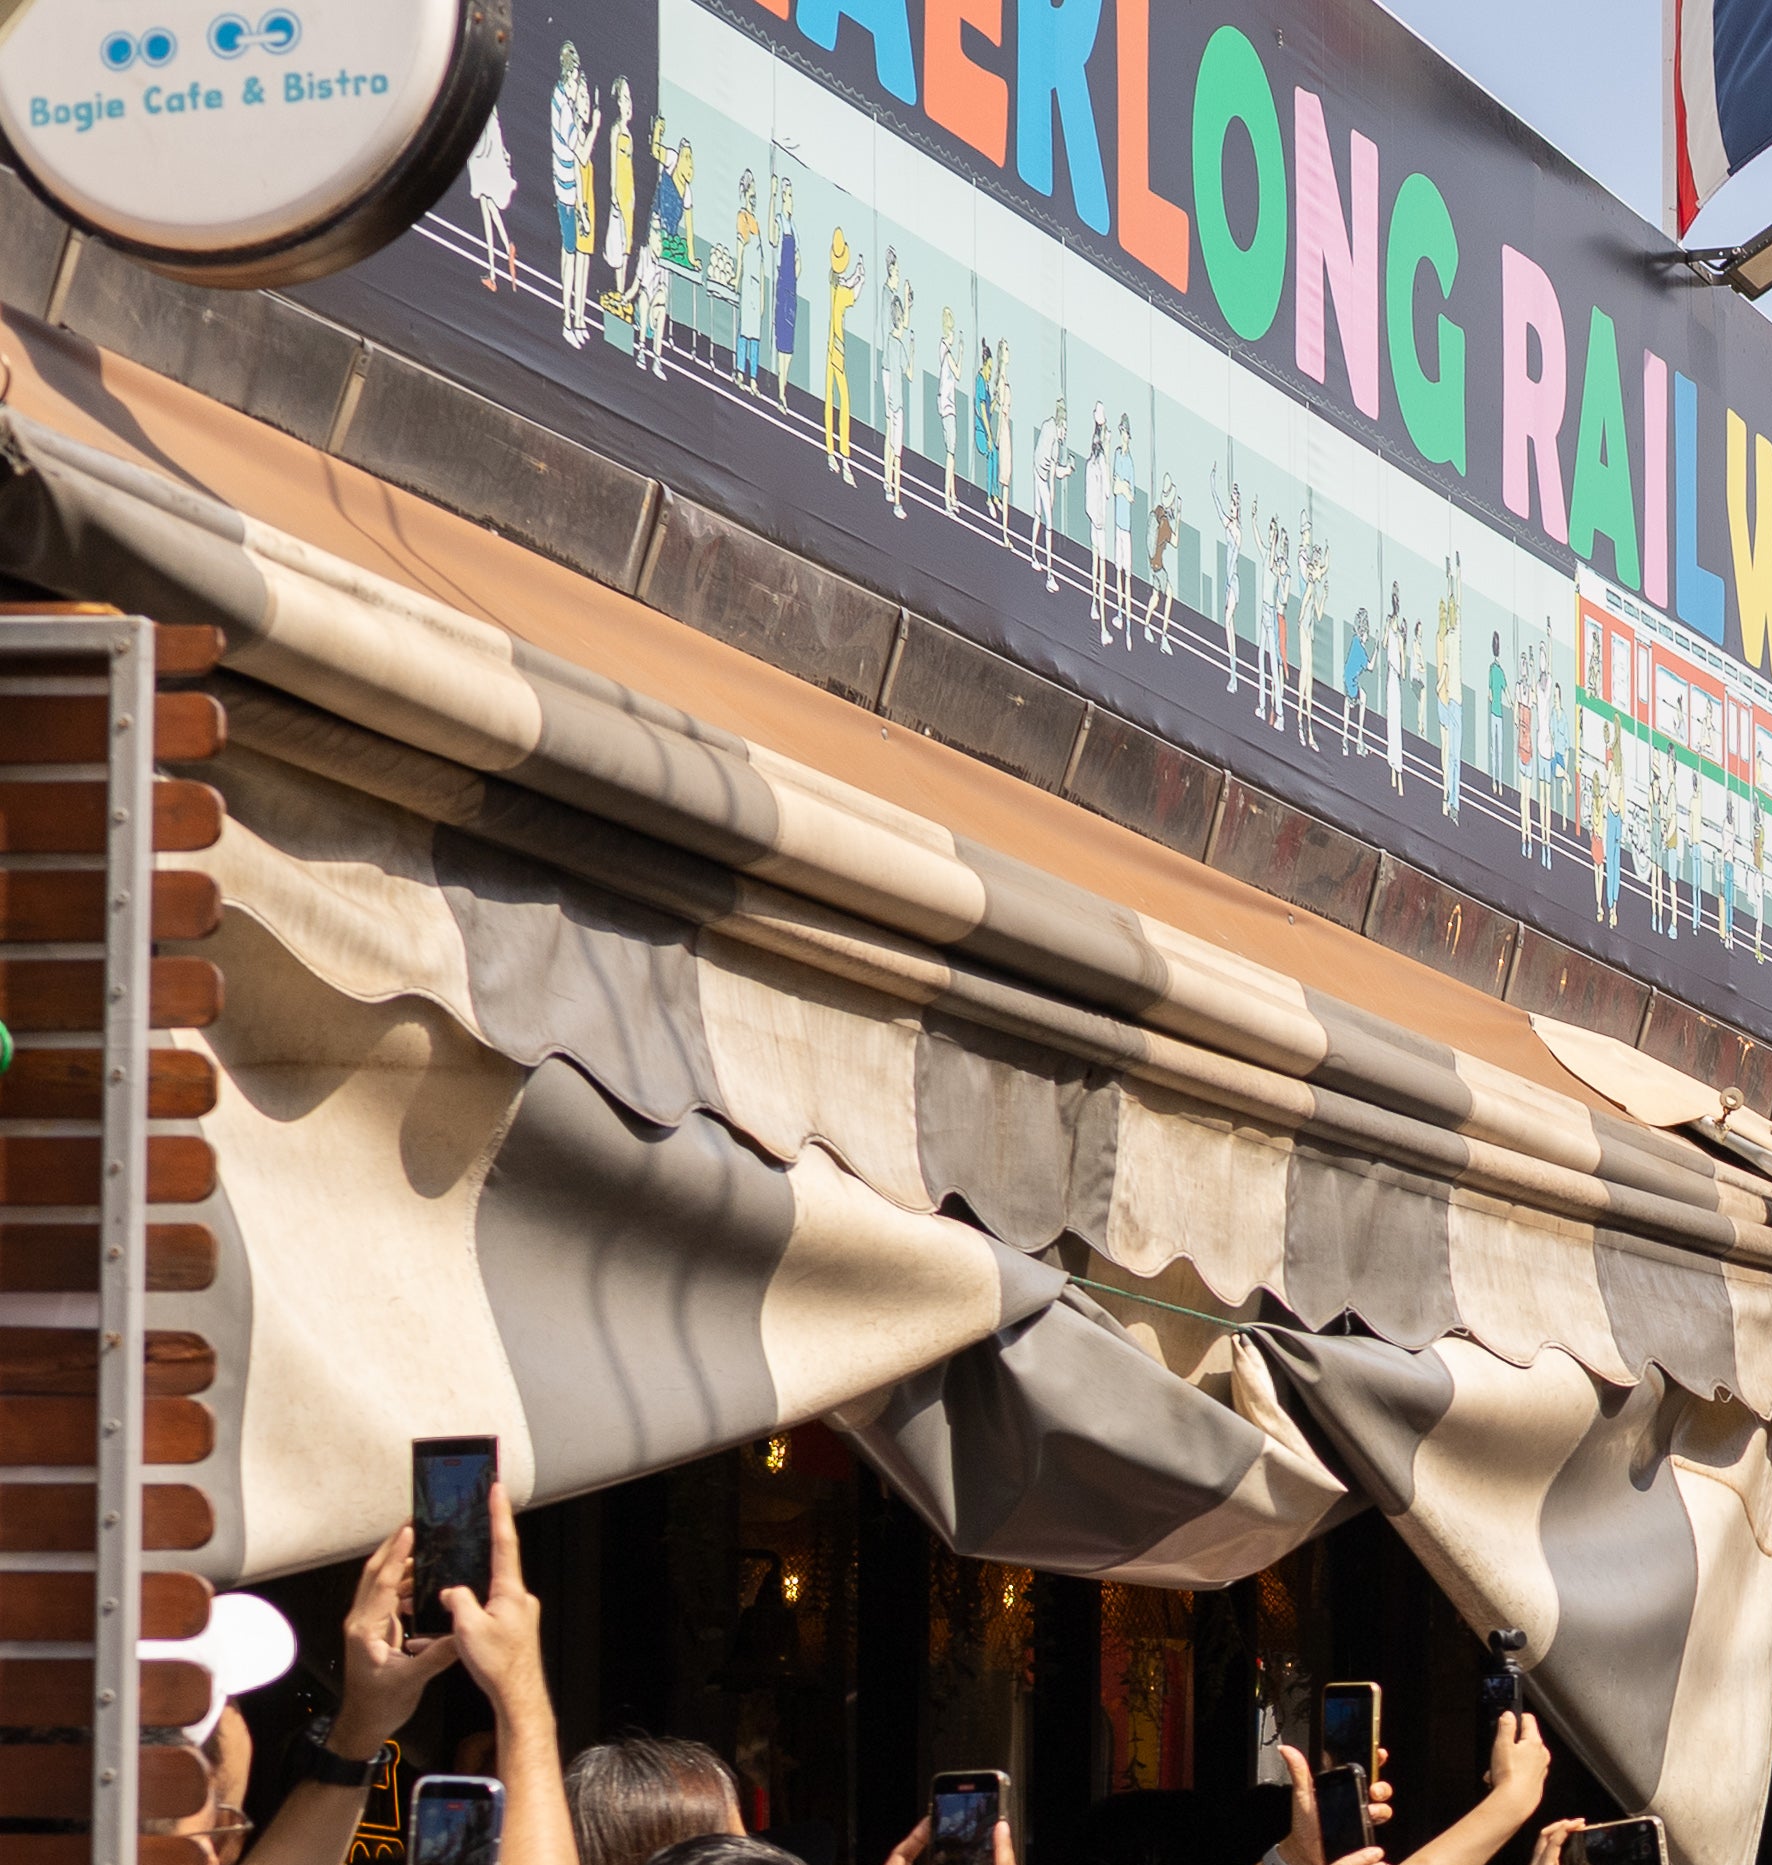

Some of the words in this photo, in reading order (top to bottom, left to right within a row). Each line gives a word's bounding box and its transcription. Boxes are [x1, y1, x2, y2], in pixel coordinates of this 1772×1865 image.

[30, 96, 125, 132] Bogie
[143, 82, 223, 115] Cafe
[242, 76, 264, 106] &
[283, 69, 389, 103] Bistro
